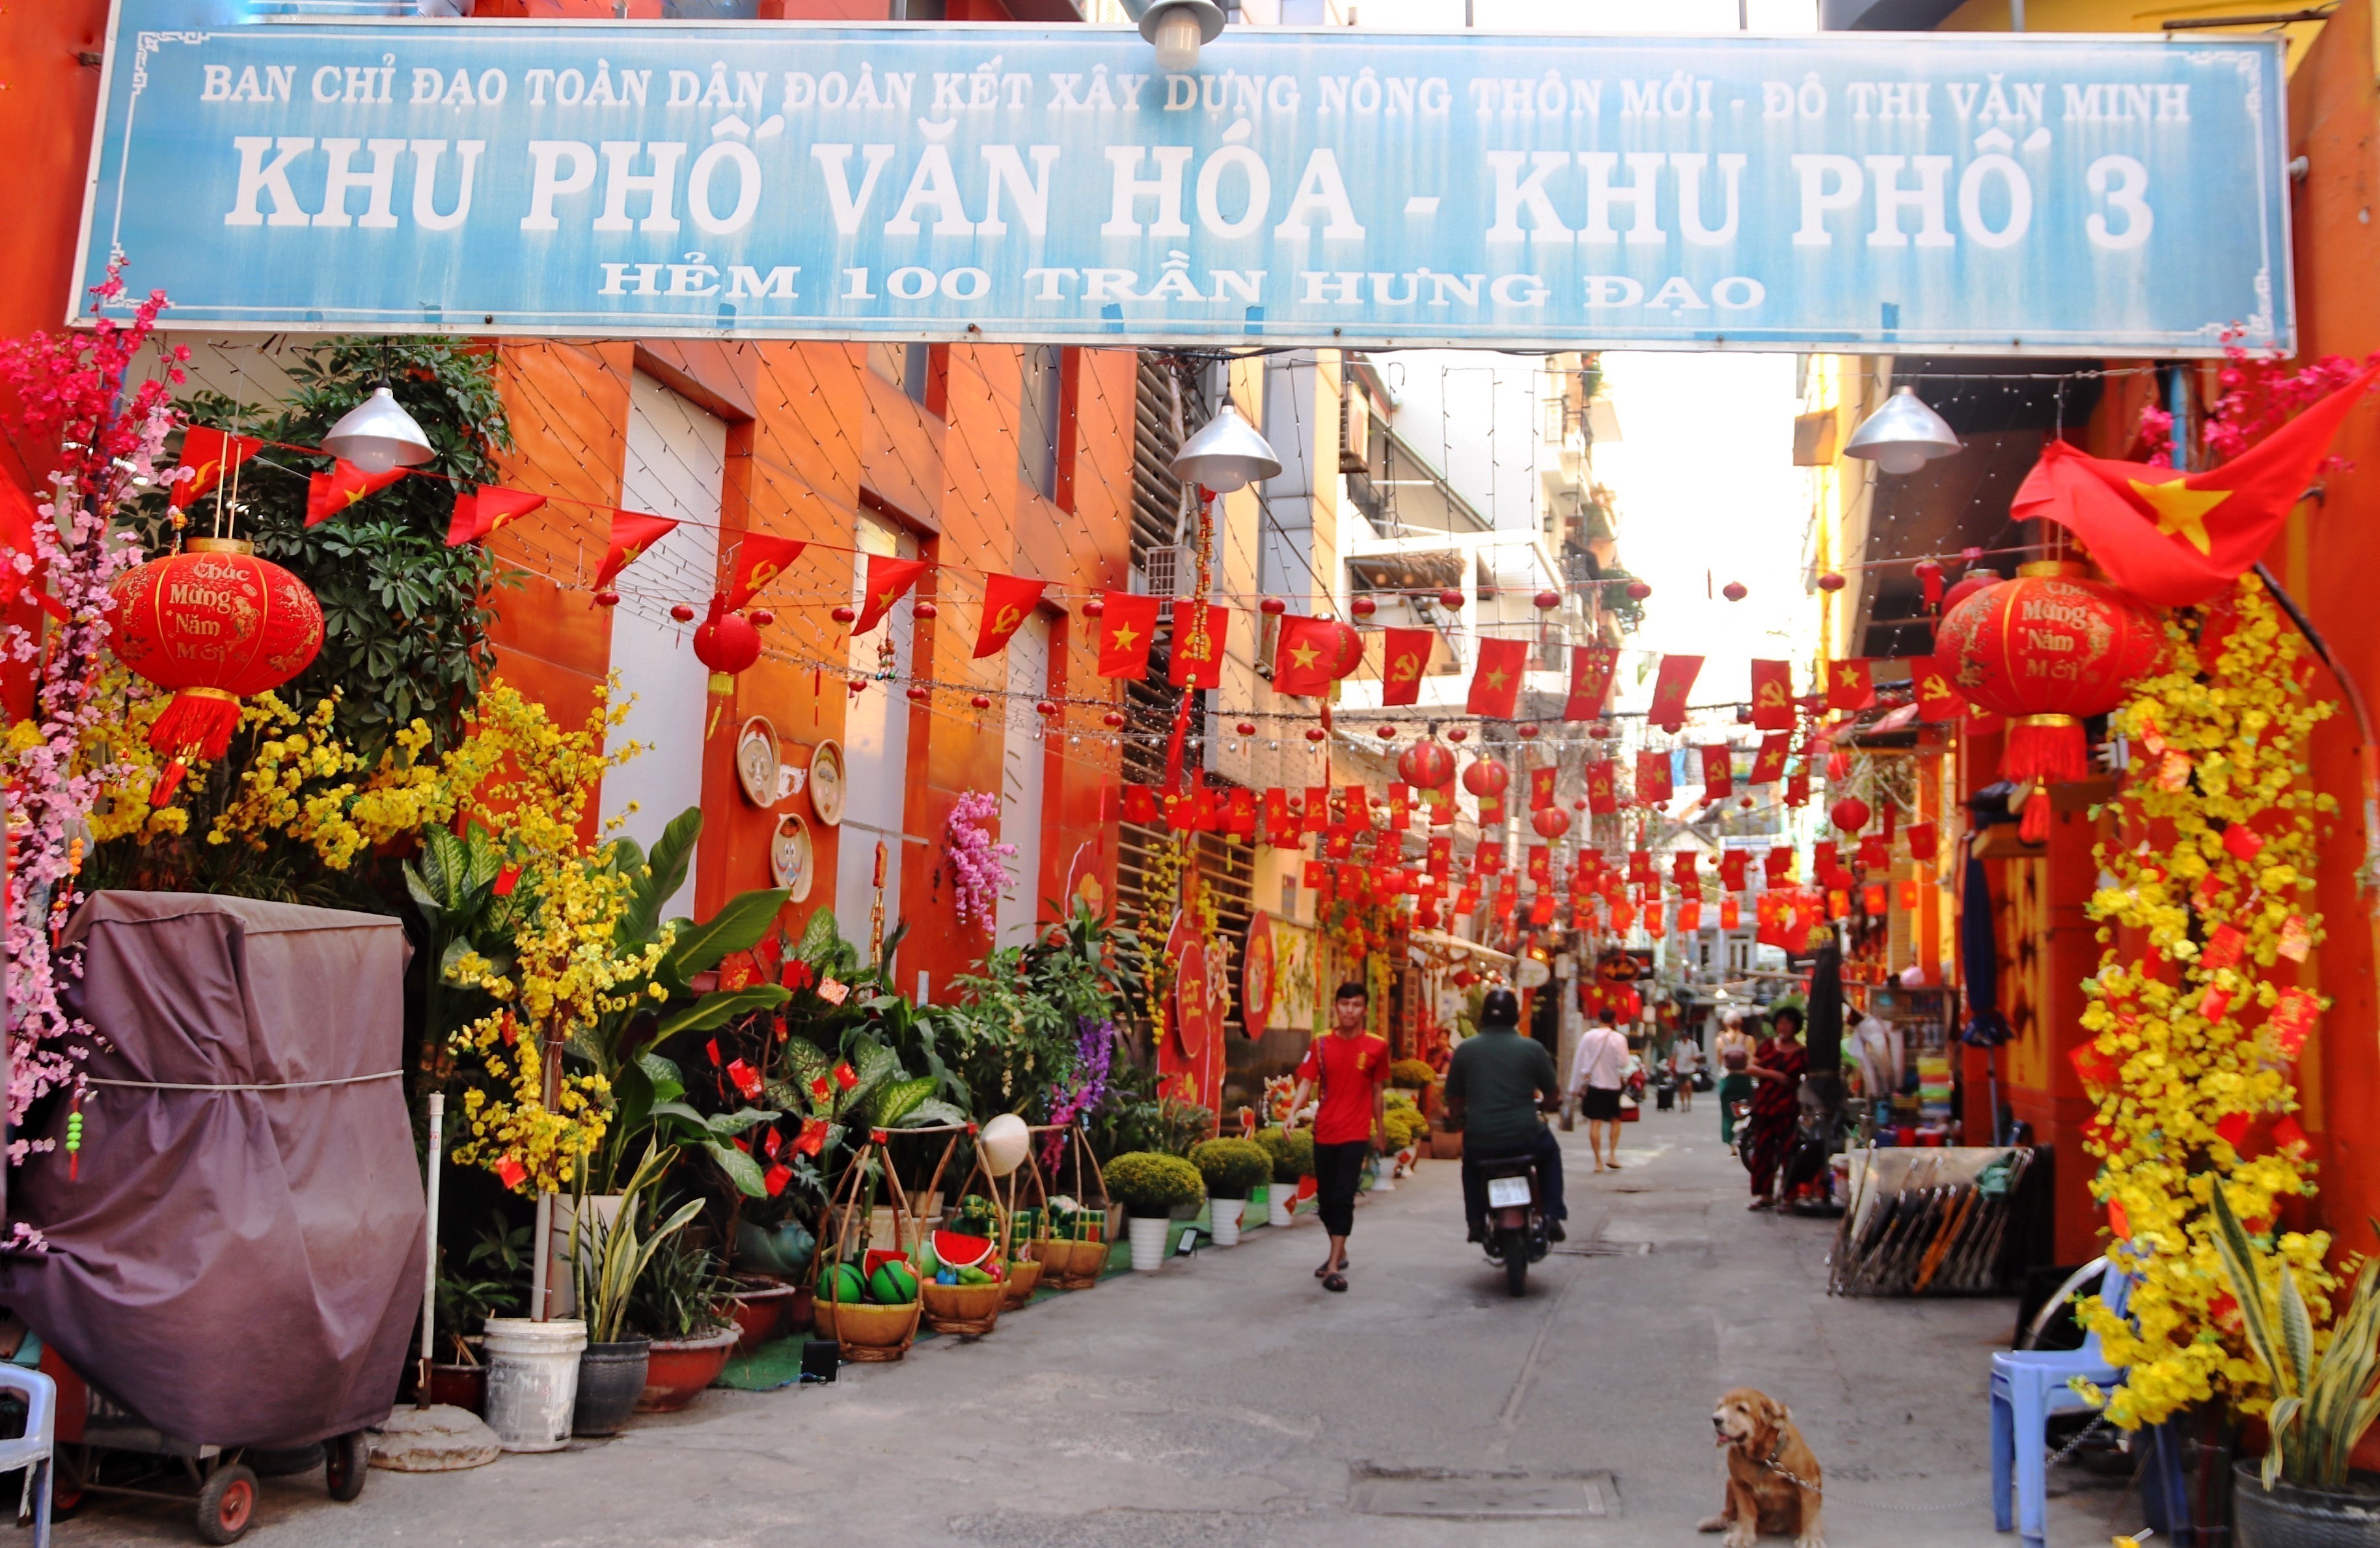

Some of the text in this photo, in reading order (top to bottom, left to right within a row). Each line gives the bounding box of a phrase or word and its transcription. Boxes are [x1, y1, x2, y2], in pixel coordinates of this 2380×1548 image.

[200, 64, 296, 101] BAN
[311, 53, 397, 103] CHỈ
[409, 67, 509, 115] ĐẠO
[525, 58, 653, 106] TOÀN
[666, 60, 769, 108] DÂN
[782, 61, 917, 109] ĐOÀN
[931, 54, 1034, 109] KẾT
[1047, 63, 1150, 111] XÂY
[1163, 67, 1301, 121] DỰNG
[1317, 65, 1453, 115] NÔNG
[1469, 68, 1603, 116] THÔN
[1619, 68, 1714, 118] MỚI
[1761, 71, 1828, 121] ĐÔ
[1945, 73, 2047, 122] VĂN
[2061, 82, 2192, 122] MINH
[224, 136, 486, 231] KHU
[520, 114, 785, 234] PHỐ
[810, 116, 1061, 236] VĂN
[1101, 117, 1366, 239] HÓA
[1485, 150, 1748, 246] KHU
[1791, 125, 2053, 249] PHỐ
[2085, 154, 2155, 249] 3
[598, 249, 1767, 318] HẺM 100 TRẦN HƯNG ĐẠO
[193, 562, 251, 582] Chúc
[175, 613, 221, 637] Năm
[176, 641, 226, 662] Mới
[2026, 657, 2079, 681] Mới
